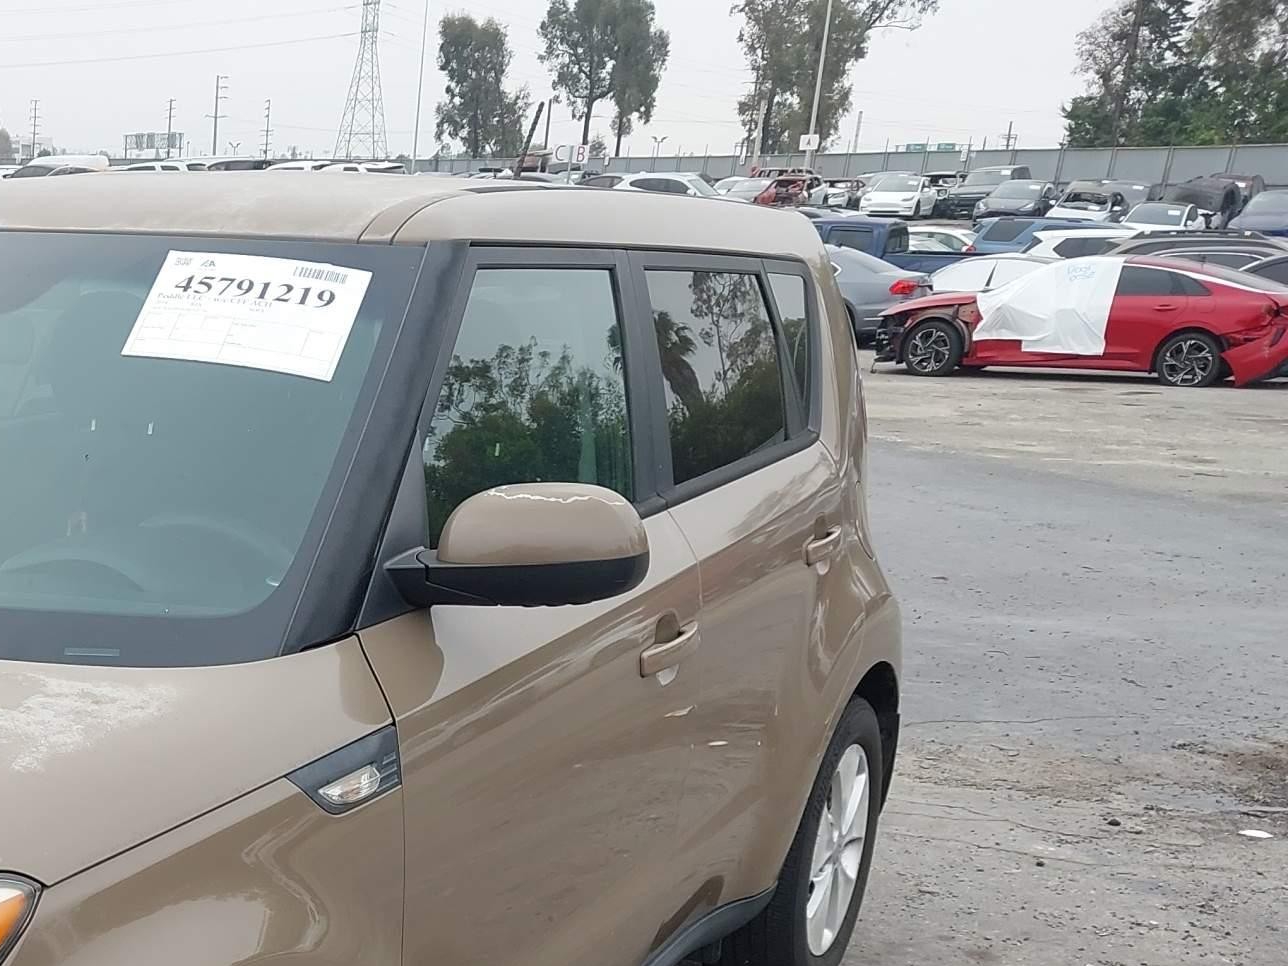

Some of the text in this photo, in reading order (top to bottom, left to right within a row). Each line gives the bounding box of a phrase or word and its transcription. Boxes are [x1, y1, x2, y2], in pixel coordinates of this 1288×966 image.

[555, 145, 567, 161] C
[576, 146, 586, 162] B
[174, 274, 336, 308] 45791219
